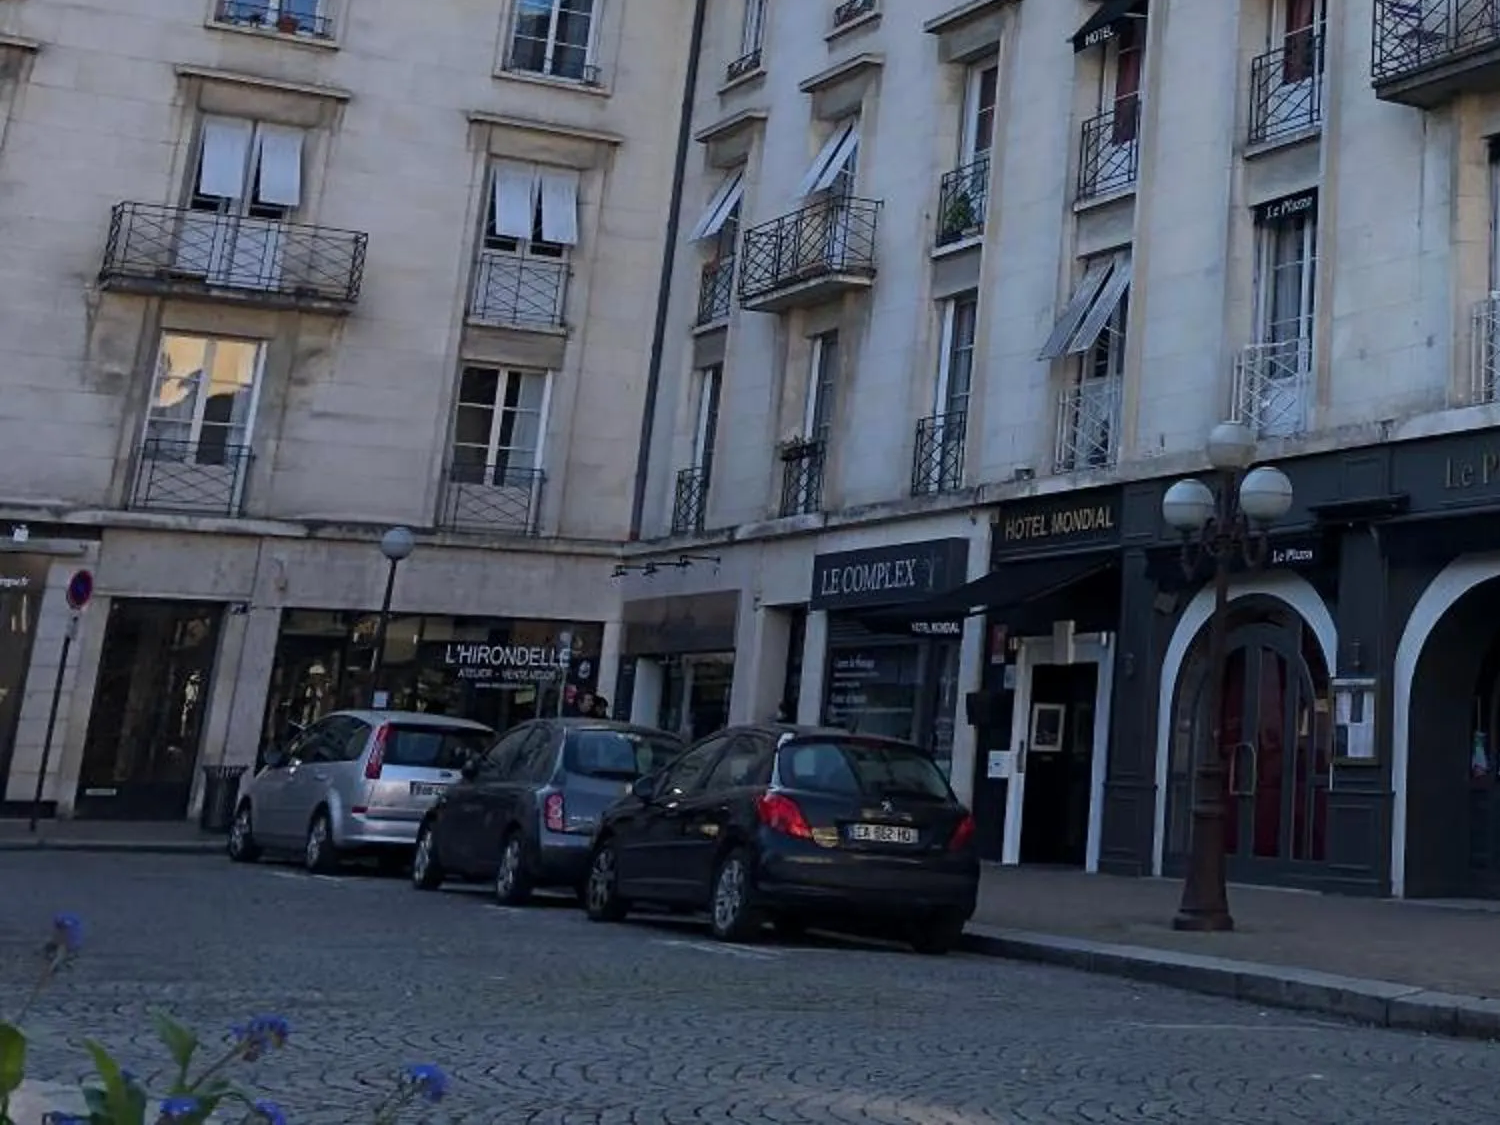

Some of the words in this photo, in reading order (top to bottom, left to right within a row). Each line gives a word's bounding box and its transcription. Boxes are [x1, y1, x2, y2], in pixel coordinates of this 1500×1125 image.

[1084, 25, 1115, 46] HOTEL
[1445, 455, 1474, 489] Le
[1005, 515, 1049, 542] HOTEL
[1050, 504, 1115, 535] MONDIAL
[1272, 548, 1285, 564] Le
[821, 568, 842, 596] LE
[842, 557, 918, 594] COMPLEX
[445, 643, 571, 669] L'HIRONDELLE
